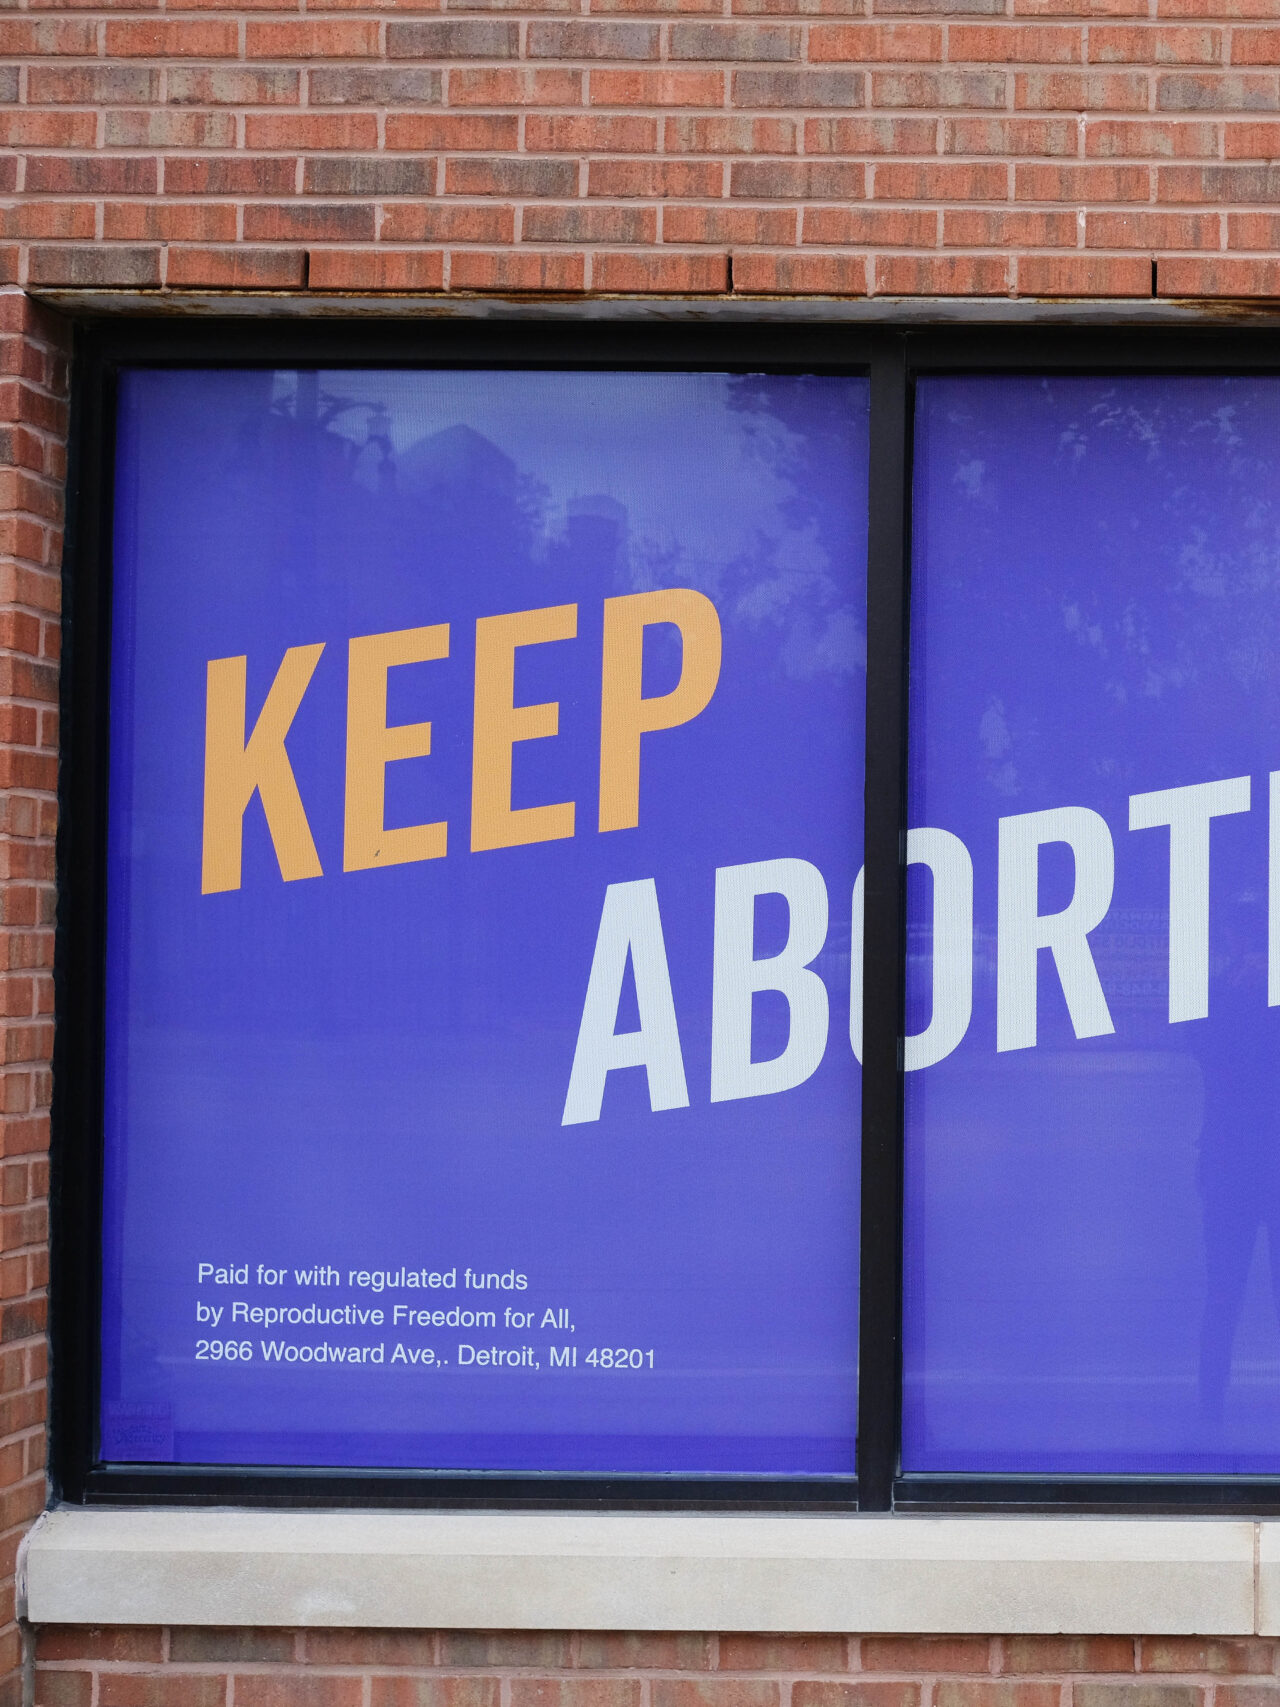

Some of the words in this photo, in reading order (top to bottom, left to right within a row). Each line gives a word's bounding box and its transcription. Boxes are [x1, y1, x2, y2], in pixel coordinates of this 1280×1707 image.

[202, 588, 722, 895] KEEP
[198, 1263, 250, 1286] Paid
[256, 1263, 289, 1286] for
[294, 1263, 341, 1287] with
[348, 1266, 457, 1293] regulated
[463, 1268, 529, 1291] funds
[196, 1300, 224, 1328] by
[232, 1301, 385, 1329] Reproductive
[393, 1304, 496, 1329] Freedom
[503, 1306, 536, 1329] for
[540, 1307, 577, 1333] All,
[195, 1339, 253, 1362] 2966
[260, 1340, 386, 1364] Woodward
[458, 1344, 541, 1371] Detroit,
[549, 1346, 578, 1369] MI
[584, 1347, 654, 1370] 48201
